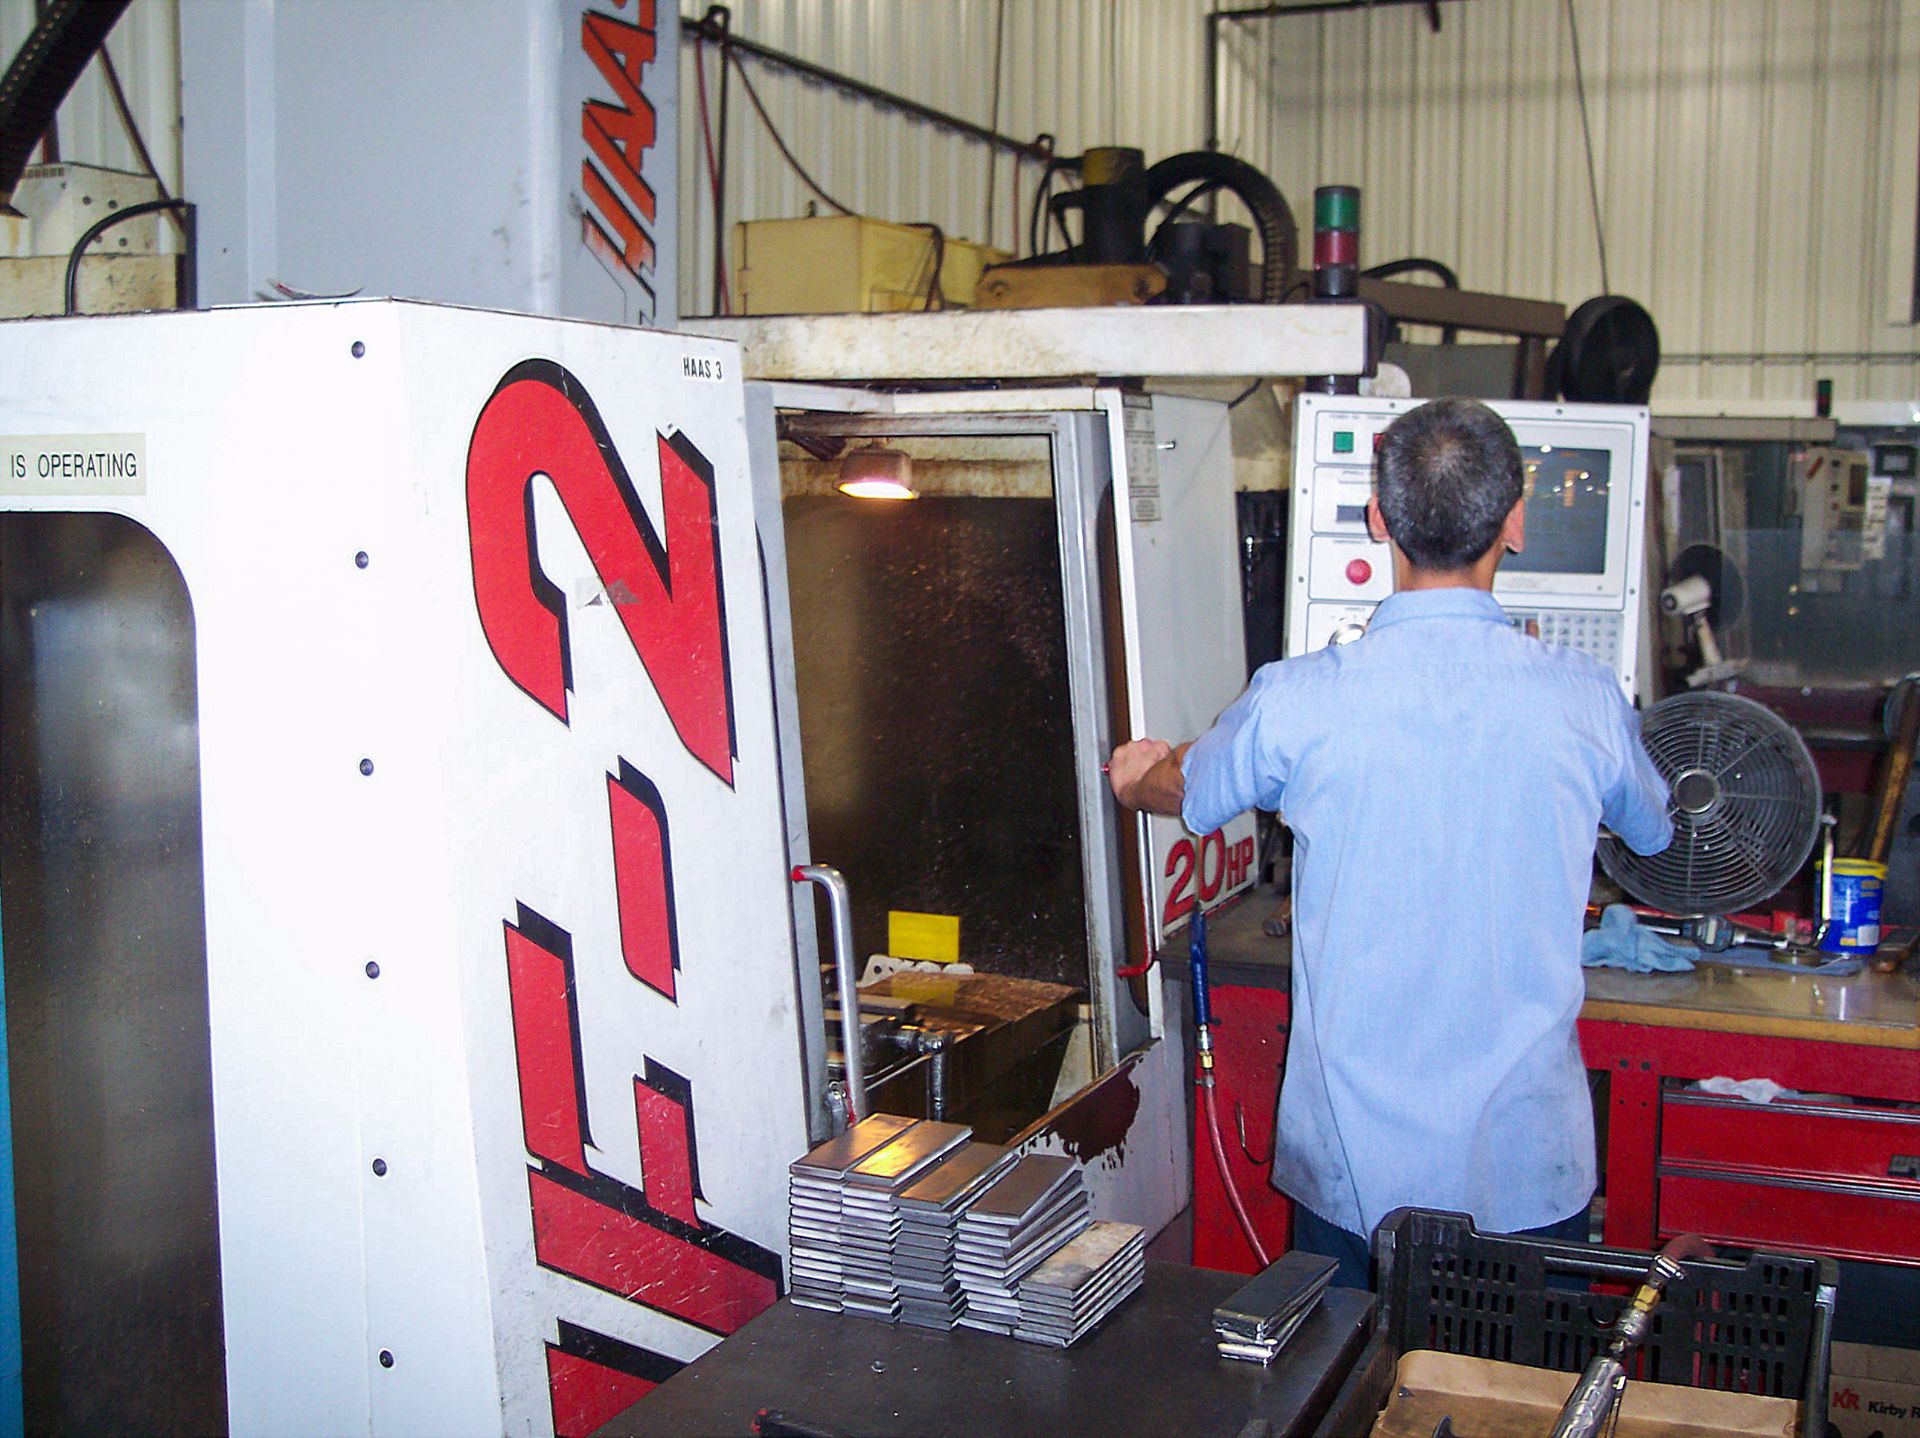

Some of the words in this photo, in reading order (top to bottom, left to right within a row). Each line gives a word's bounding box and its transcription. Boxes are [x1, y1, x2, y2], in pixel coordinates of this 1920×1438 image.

[683, 357, 711, 379] HAAS
[715, 360, 723, 380] 3
[10, 454, 27, 478] IS
[38, 452, 137, 478] OPERATING
[1868, 1401, 1907, 1419] Kirby
